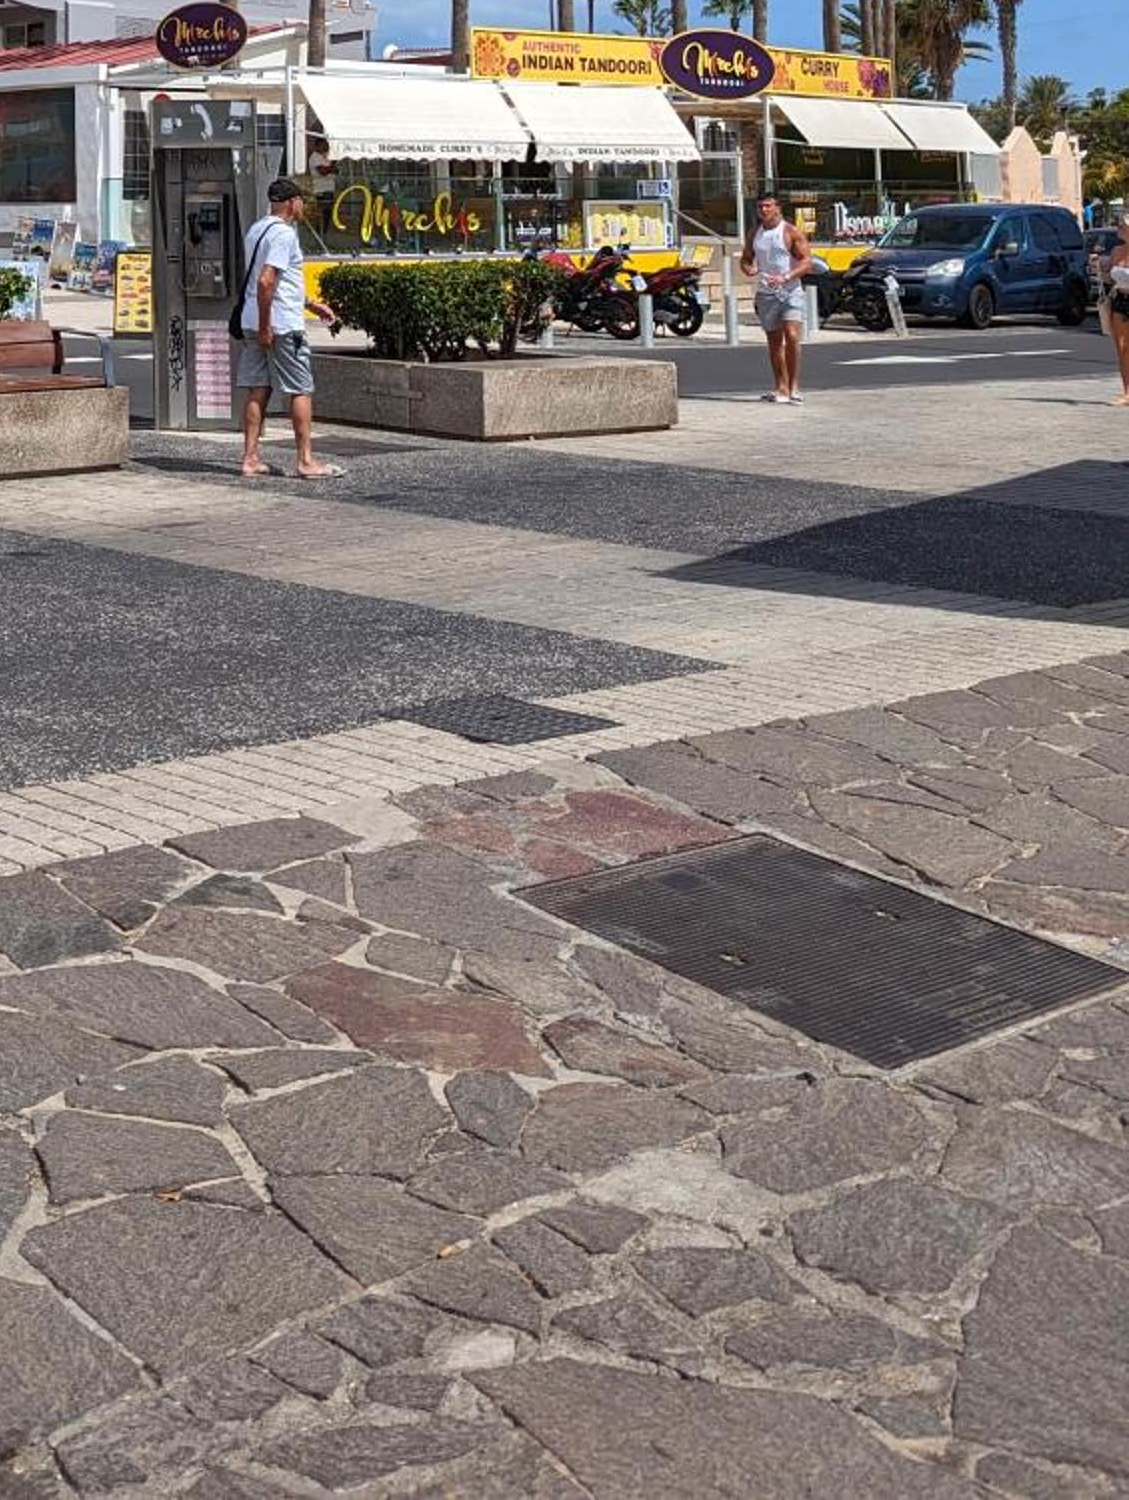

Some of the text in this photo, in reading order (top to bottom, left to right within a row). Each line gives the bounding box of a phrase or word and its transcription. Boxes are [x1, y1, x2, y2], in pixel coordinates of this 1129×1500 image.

[522, 40, 581, 54] AUTHENTIC
[522, 54, 652, 75] INDIAN TANDOORI
[800, 58, 840, 78] CURRY
[699, 76, 744, 87] TANDOORI
[822, 78, 850, 92] HOUSE
[378, 144, 436, 153] HOMEMADE
